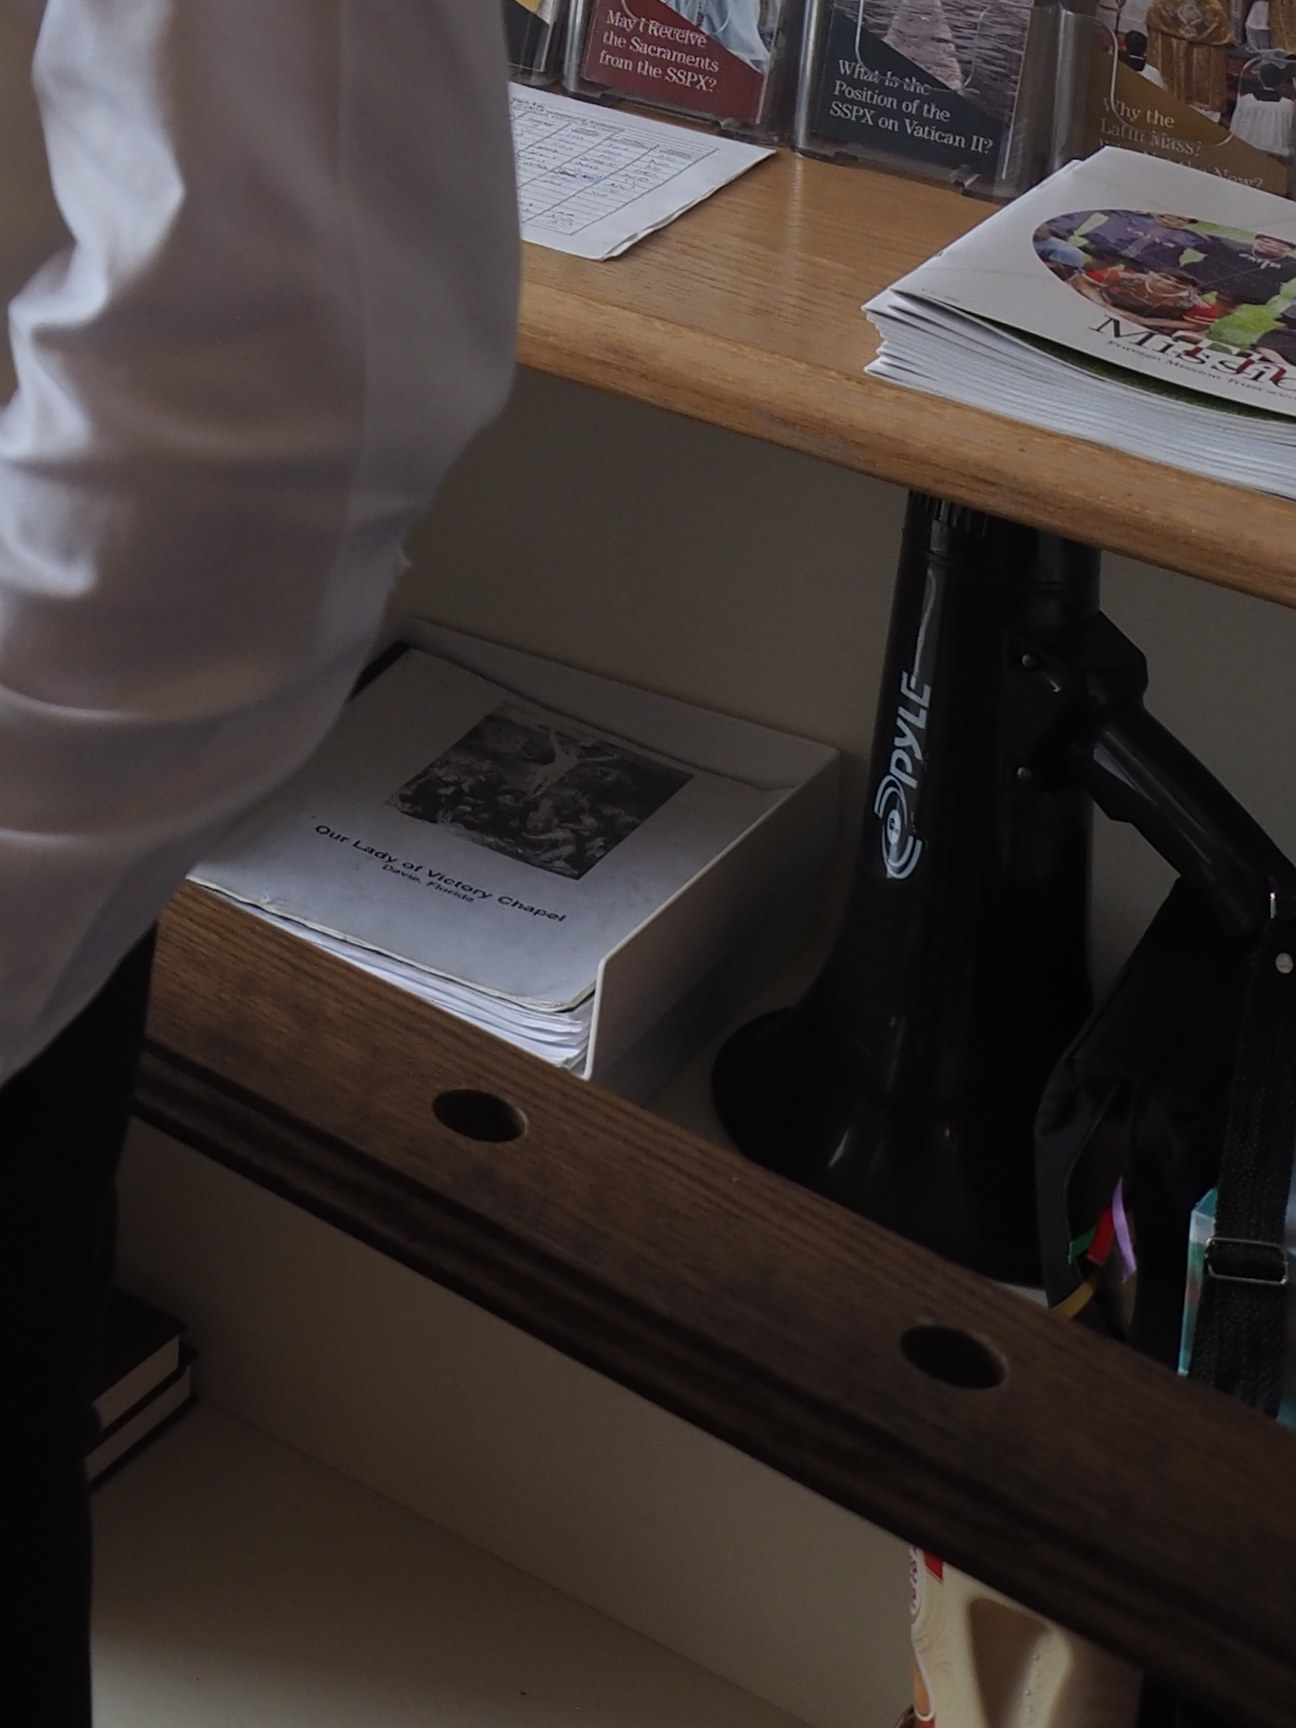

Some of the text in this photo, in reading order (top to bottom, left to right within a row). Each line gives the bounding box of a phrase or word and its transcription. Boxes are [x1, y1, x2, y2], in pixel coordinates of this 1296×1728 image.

[607, 10, 637, 32] May
[599, 49, 716, 92] from the SSPX?
[603, 31, 720, 73] the Sacraments
[833, 79, 950, 122] Position of the
[1146, 109, 1175, 129] the
[830, 101, 992, 153] SSPX on Vatican II?
[889, 670, 932, 790] PYLE
[316, 825, 566, 922] Our Lady of Victory Chapel
[426, 881, 474, 903] Florida
